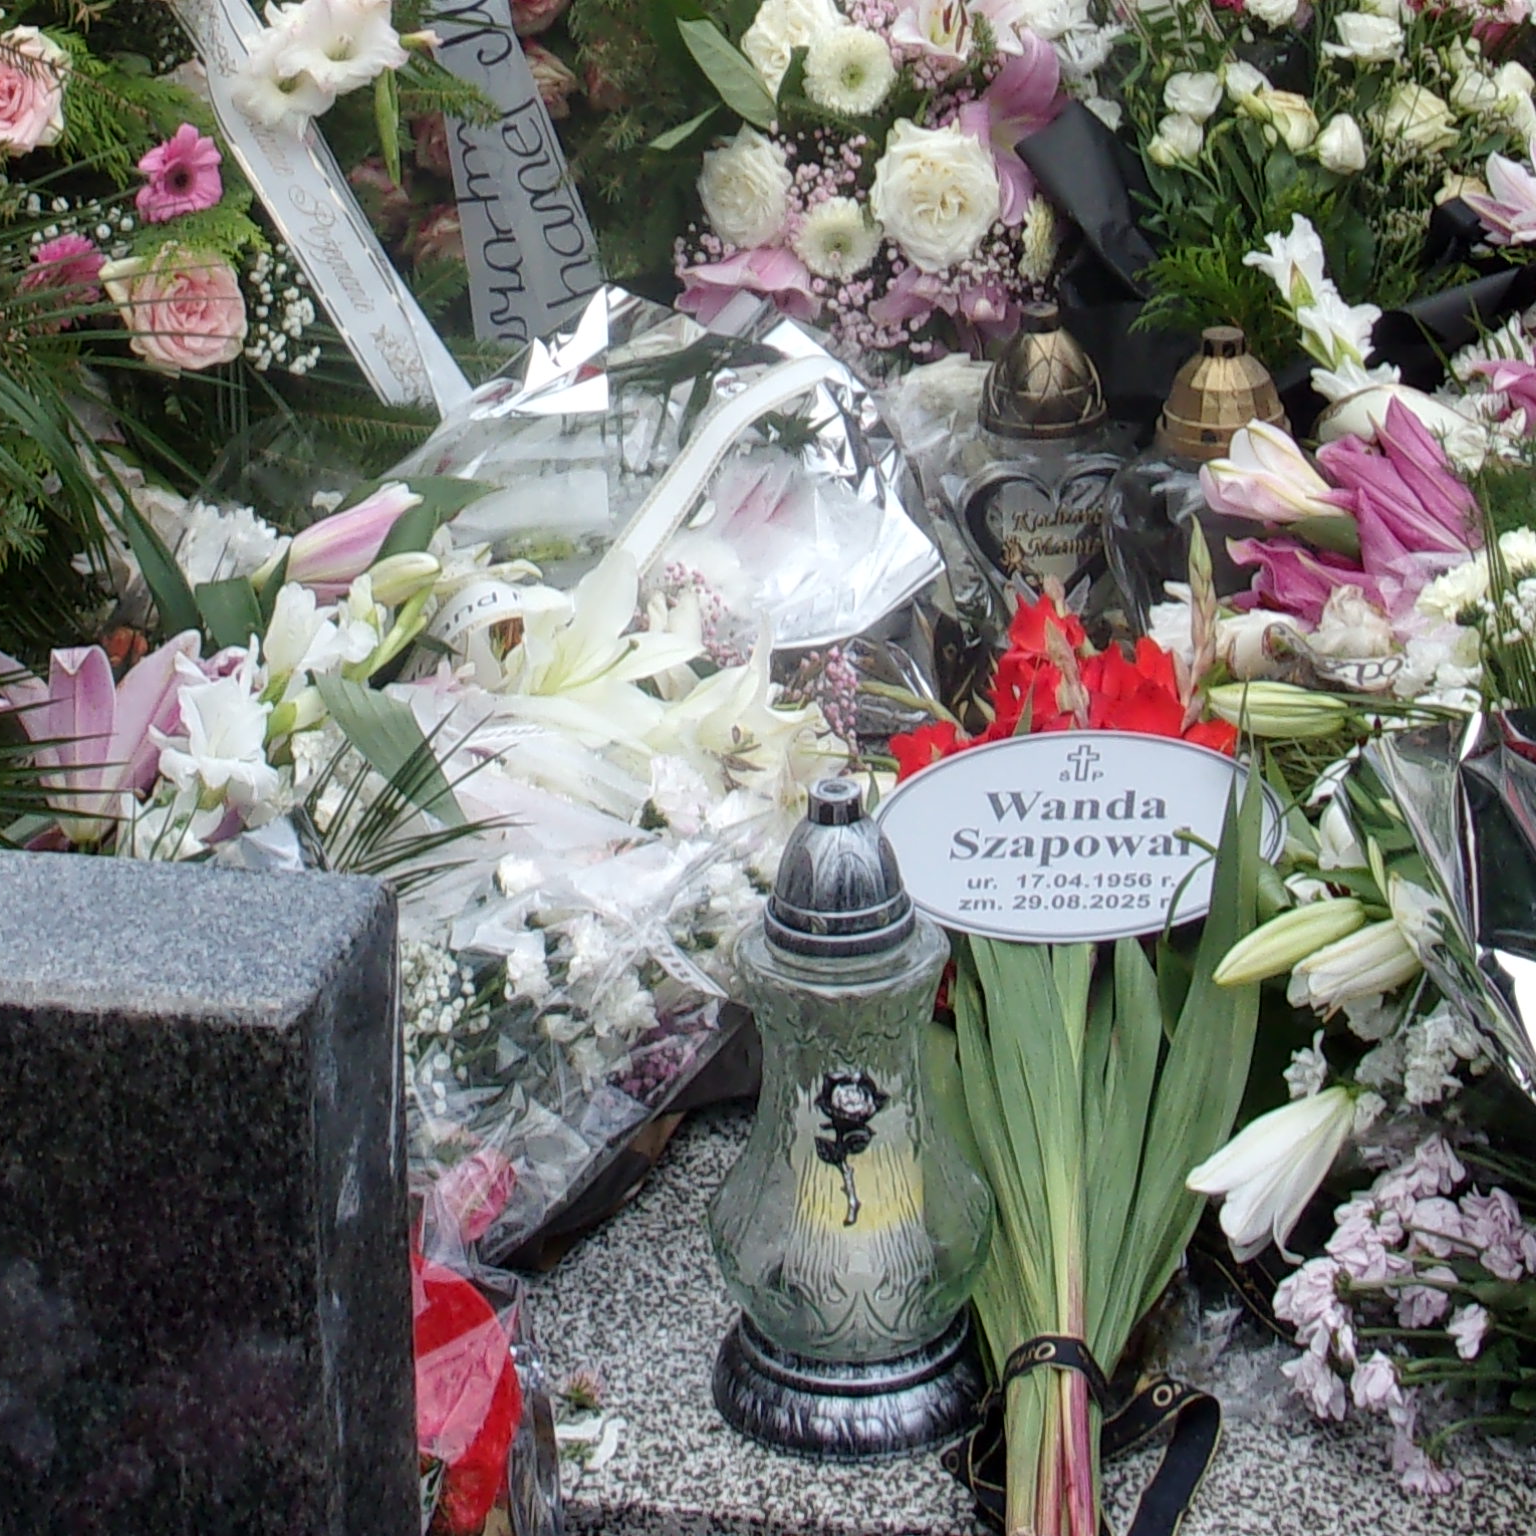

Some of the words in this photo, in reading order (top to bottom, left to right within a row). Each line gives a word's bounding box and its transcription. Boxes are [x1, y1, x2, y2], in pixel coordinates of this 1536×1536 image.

[985, 789, 1167, 823] Wanda
[967, 874, 998, 891] ur.
[1015, 872, 1153, 890] 17.04.1956
[1161, 875, 1177, 889] r.
[958, 896, 1003, 912] zm.
[1011, 893, 1152, 912] 29.08.2025
